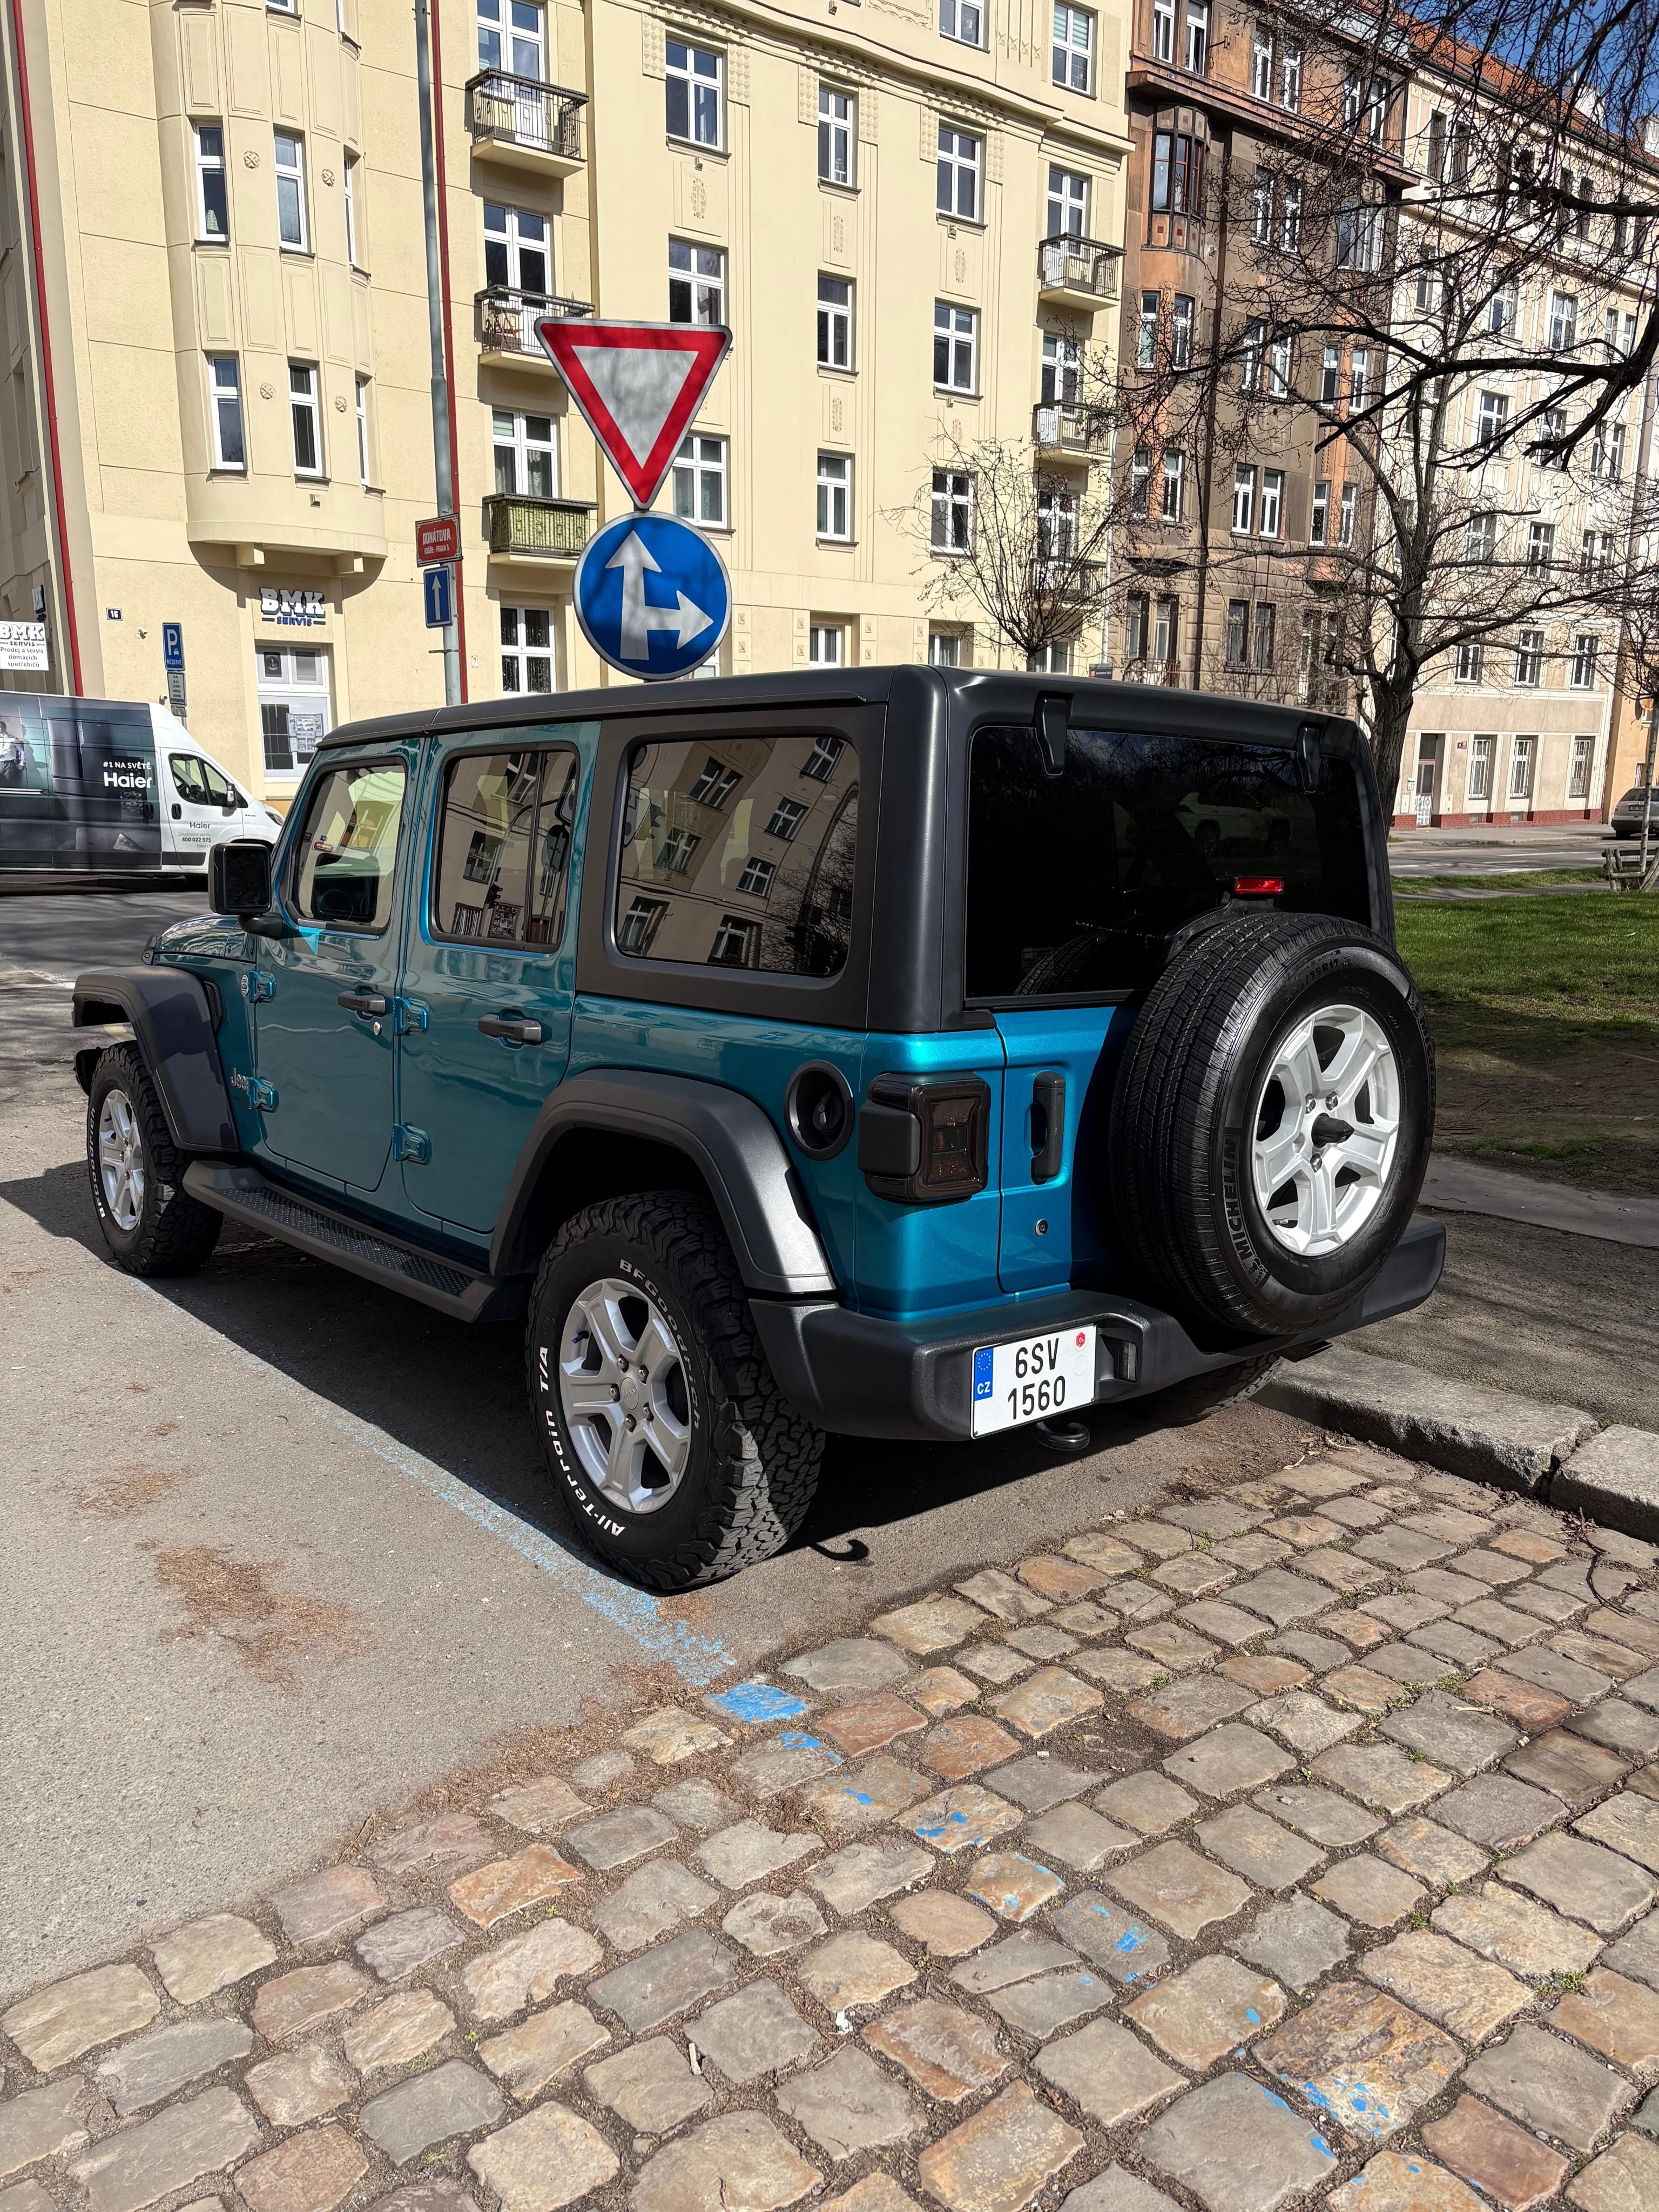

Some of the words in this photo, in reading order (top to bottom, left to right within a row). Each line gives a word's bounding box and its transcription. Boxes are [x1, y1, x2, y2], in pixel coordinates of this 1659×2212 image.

[423, 528, 451, 545] DONÁTOVA
[110, 610, 119, 618] 16
[259, 588, 326, 619] BMK
[0, 623, 44, 642] BMK
[276, 616, 312, 626] SERVIS
[103, 772, 152, 788] Haier
[127, 761, 151, 770] SVĚTĚ
[89, 1107, 106, 1218] BFGoodrich
[1223, 1137, 1255, 1260] MICHELIN
[619, 1258, 700, 1430] BFGoodrich
[1015, 1337, 1060, 1379] 6SV
[539, 1347, 549, 1393] T/A
[977, 1381, 991, 1395] CZ
[1008, 1375, 1065, 1420] 1560
[544, 1410, 625, 1537] All-Terrain
